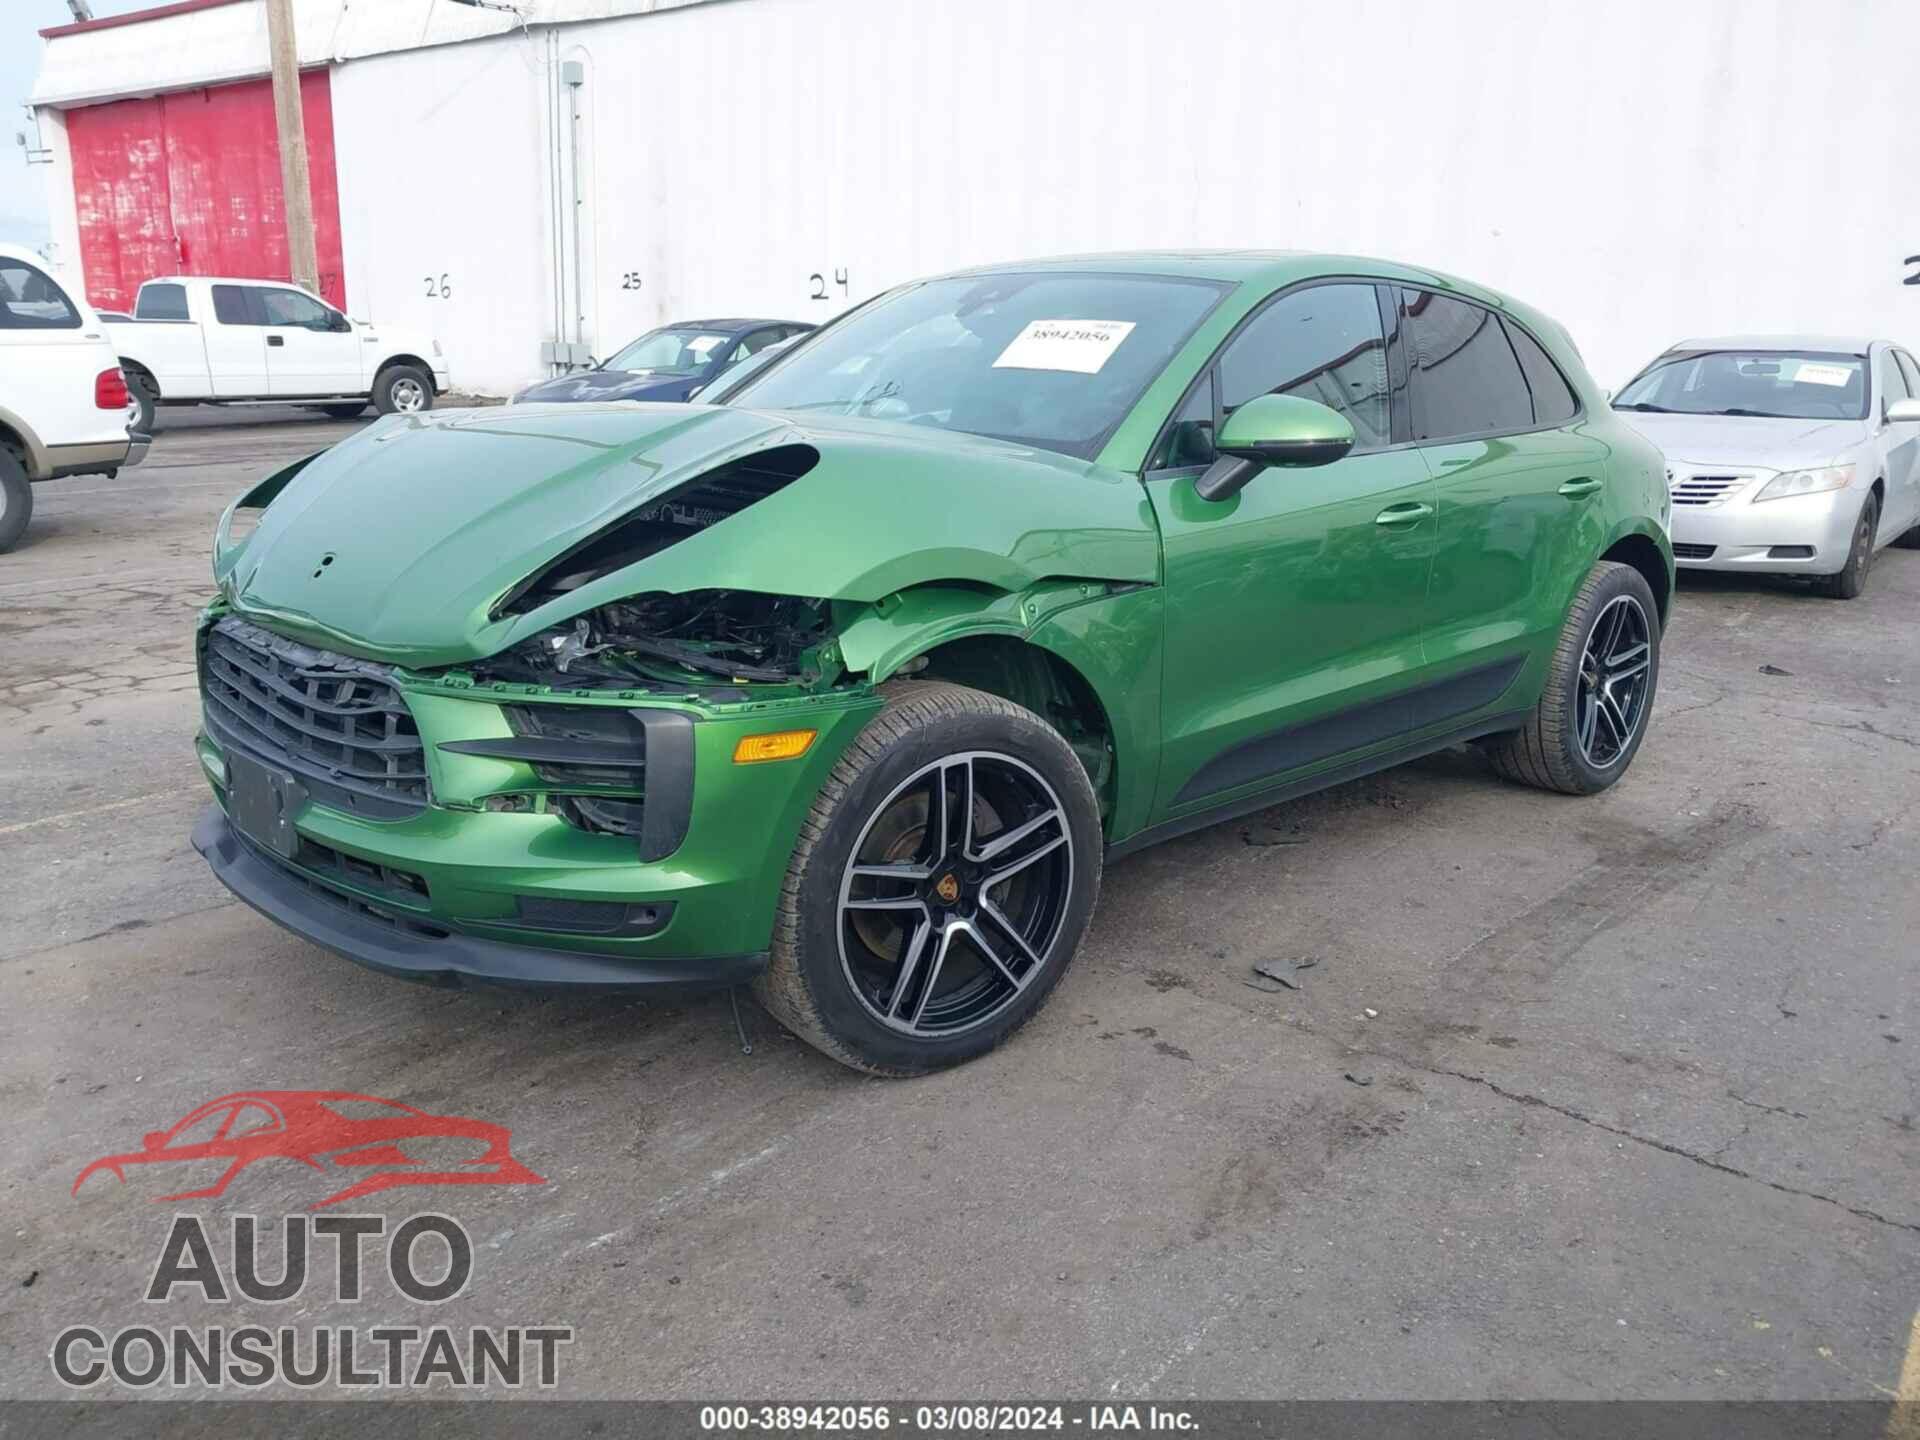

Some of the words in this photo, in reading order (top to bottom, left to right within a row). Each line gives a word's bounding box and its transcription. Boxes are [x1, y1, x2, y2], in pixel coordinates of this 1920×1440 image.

[424, 273, 451, 299] 26
[622, 272, 641, 290] 25
[810, 267, 848, 300] 24
